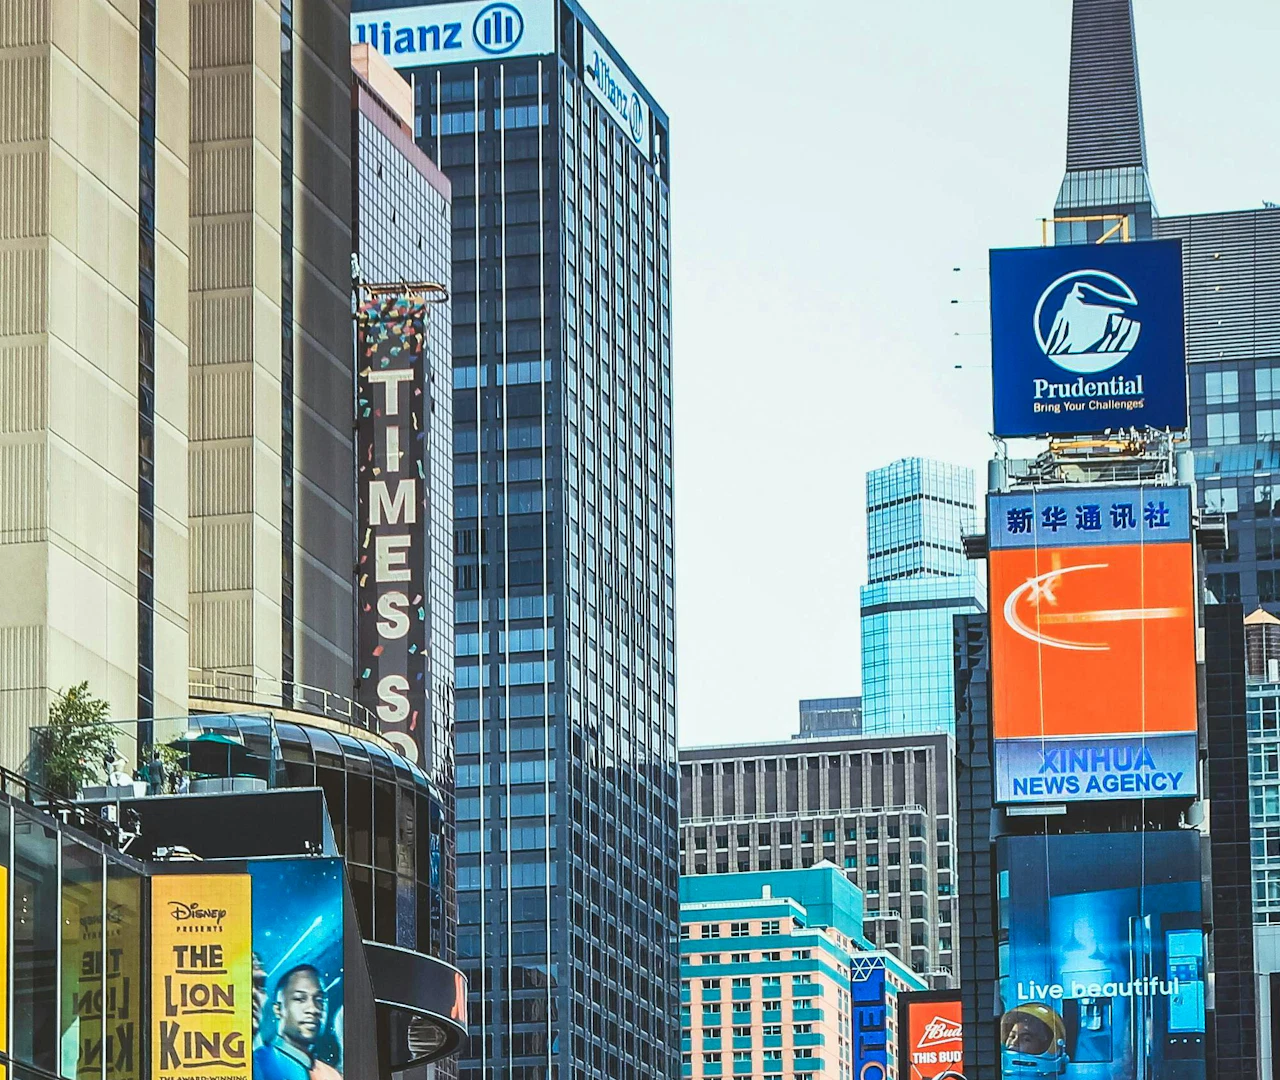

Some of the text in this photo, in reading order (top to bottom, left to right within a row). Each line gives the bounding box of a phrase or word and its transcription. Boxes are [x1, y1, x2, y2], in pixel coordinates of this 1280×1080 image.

[591, 50, 628, 119] Allianz
[1033, 375, 1144, 400] Prudential
[1033, 399, 1144, 414] Bring Your Challenges
[368, 369, 417, 640] TIMES
[1006, 500, 1171, 534] 新华通讯社
[1037, 744, 1157, 775] XINHUA
[1013, 771, 1184, 796] NEWS AGENCY
[167, 901, 228, 925] Disney
[173, 944, 223, 968] THE
[164, 975, 235, 1017] LION
[1017, 976, 1181, 1000] Live beautiful
[159, 1020, 246, 1070] KING
[912, 1051, 937, 1065] THIS
